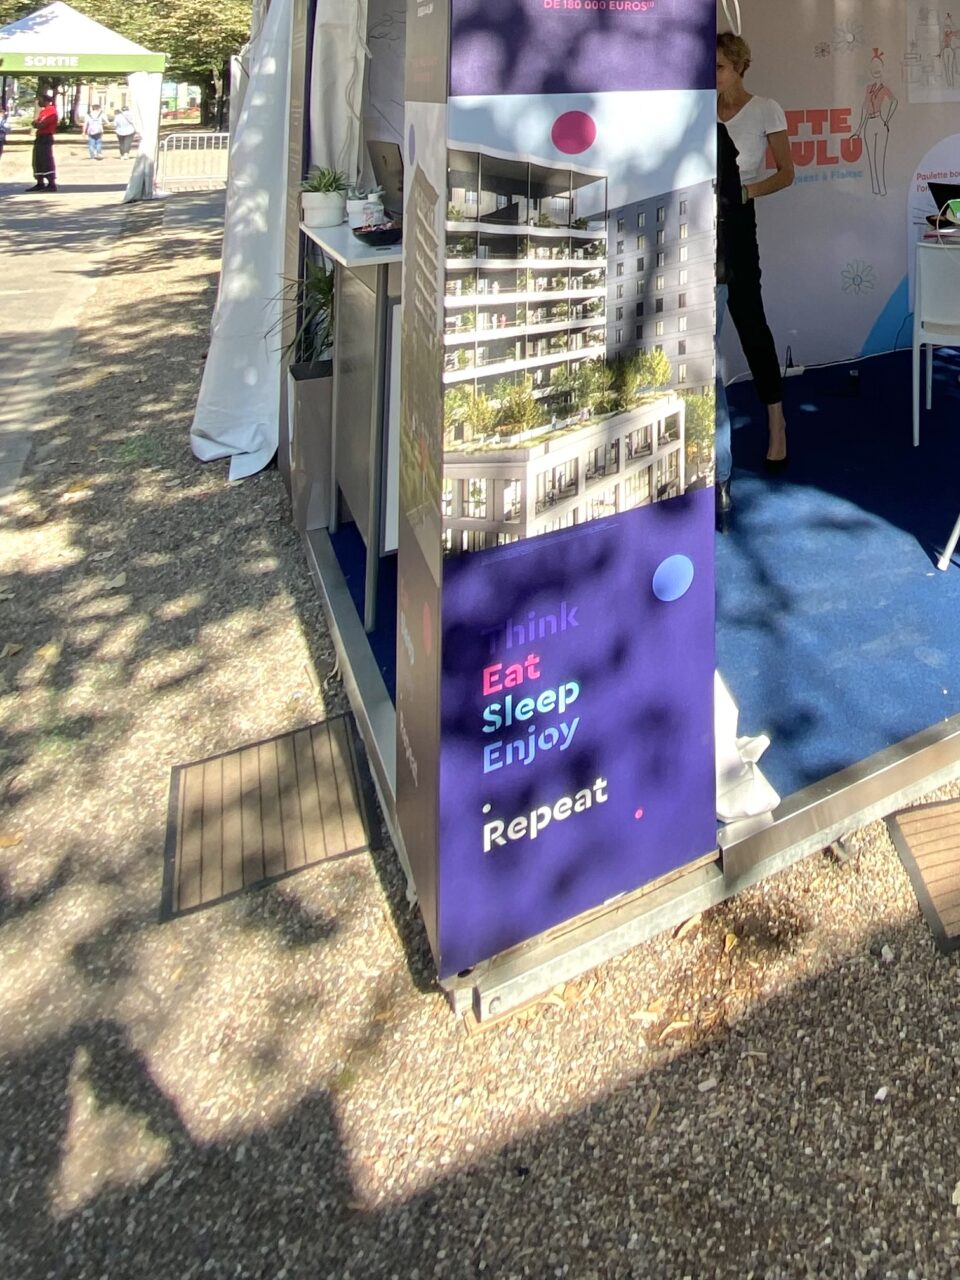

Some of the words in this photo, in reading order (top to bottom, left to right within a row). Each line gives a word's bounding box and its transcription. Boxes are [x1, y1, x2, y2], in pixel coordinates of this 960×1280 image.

[544, 0, 560, 9] DE
[563, 0, 581, 9] 180
[584, 0, 606, 10] 000
[24, 55, 79, 67] SORTIE
[483, 652, 541, 696] Eat
[482, 680, 580, 733] Sleep
[483, 716, 580, 774] Enjoy
[483, 776, 609, 853] Repeat
